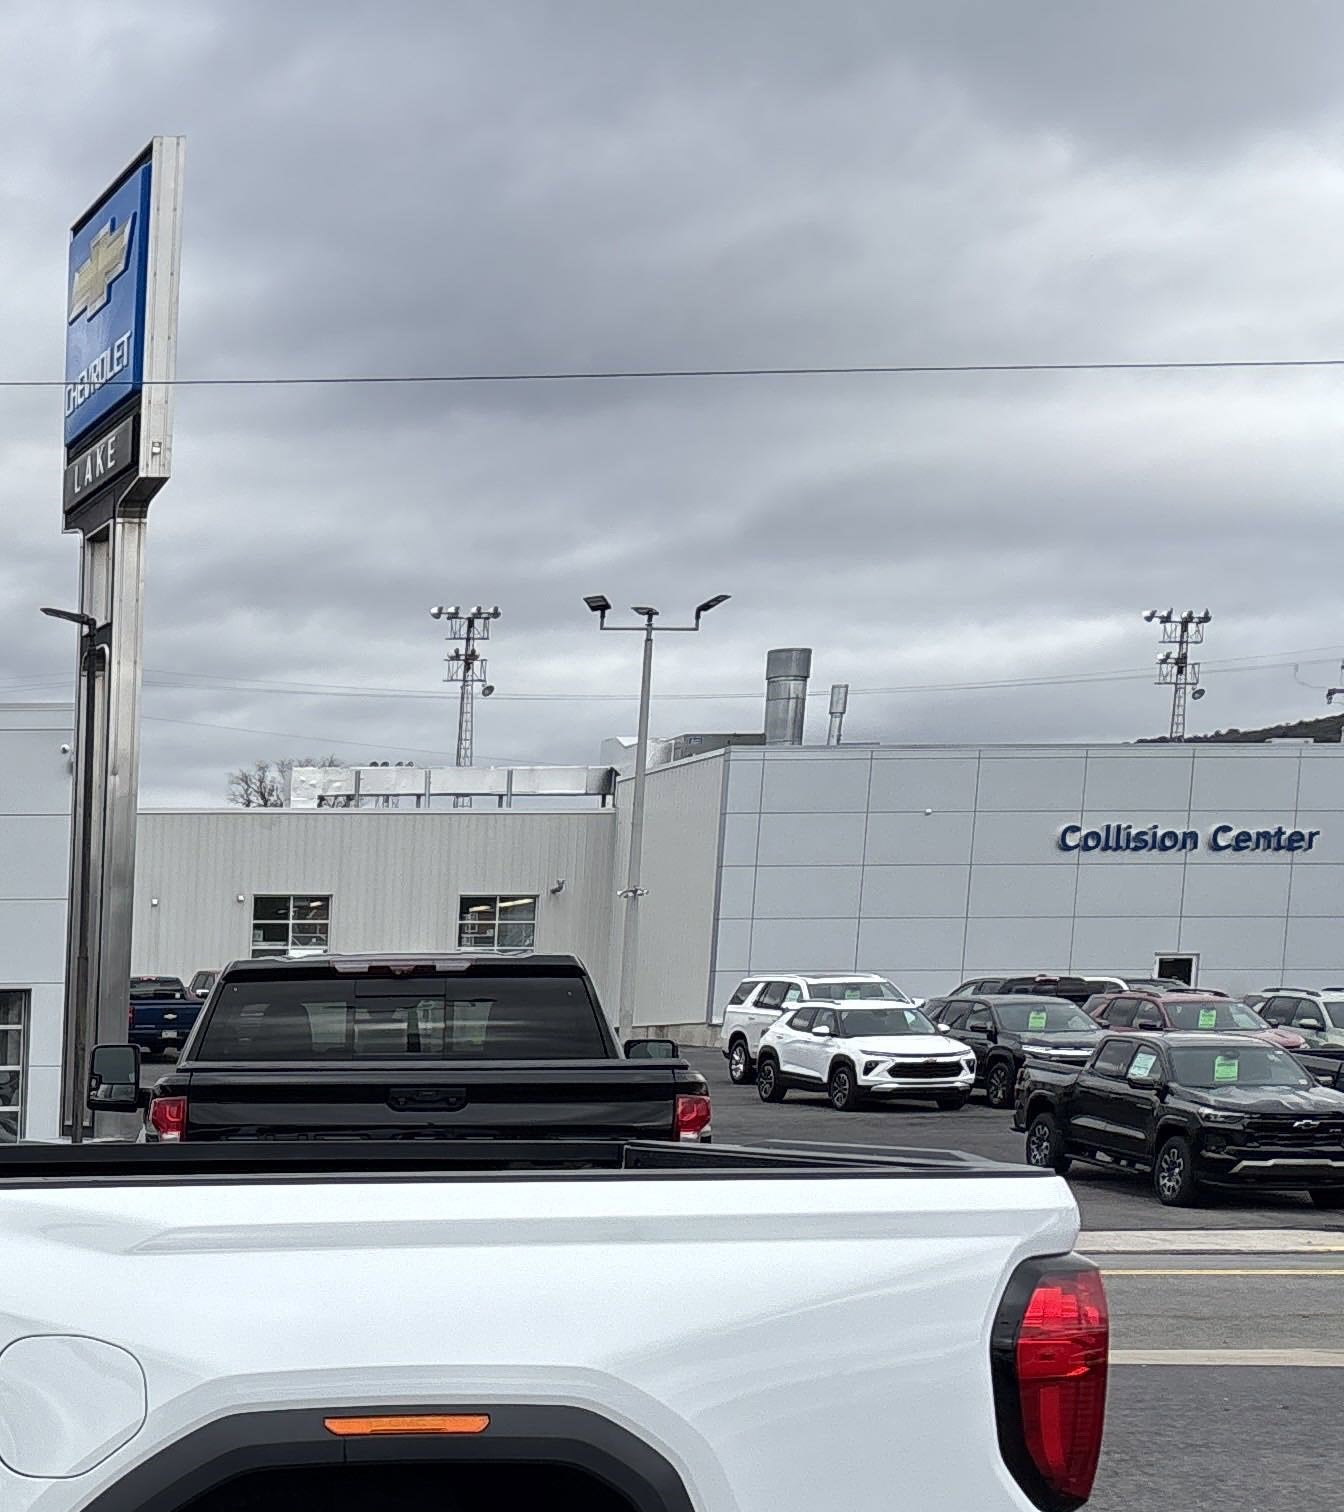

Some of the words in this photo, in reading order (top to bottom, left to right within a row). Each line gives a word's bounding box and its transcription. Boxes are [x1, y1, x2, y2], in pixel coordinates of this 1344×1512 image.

[65, 330, 131, 417] CHEVROLET
[73, 436, 116, 493] LAKE
[1059, 824, 1200, 851] Collision
[1209, 824, 1321, 851] Center
